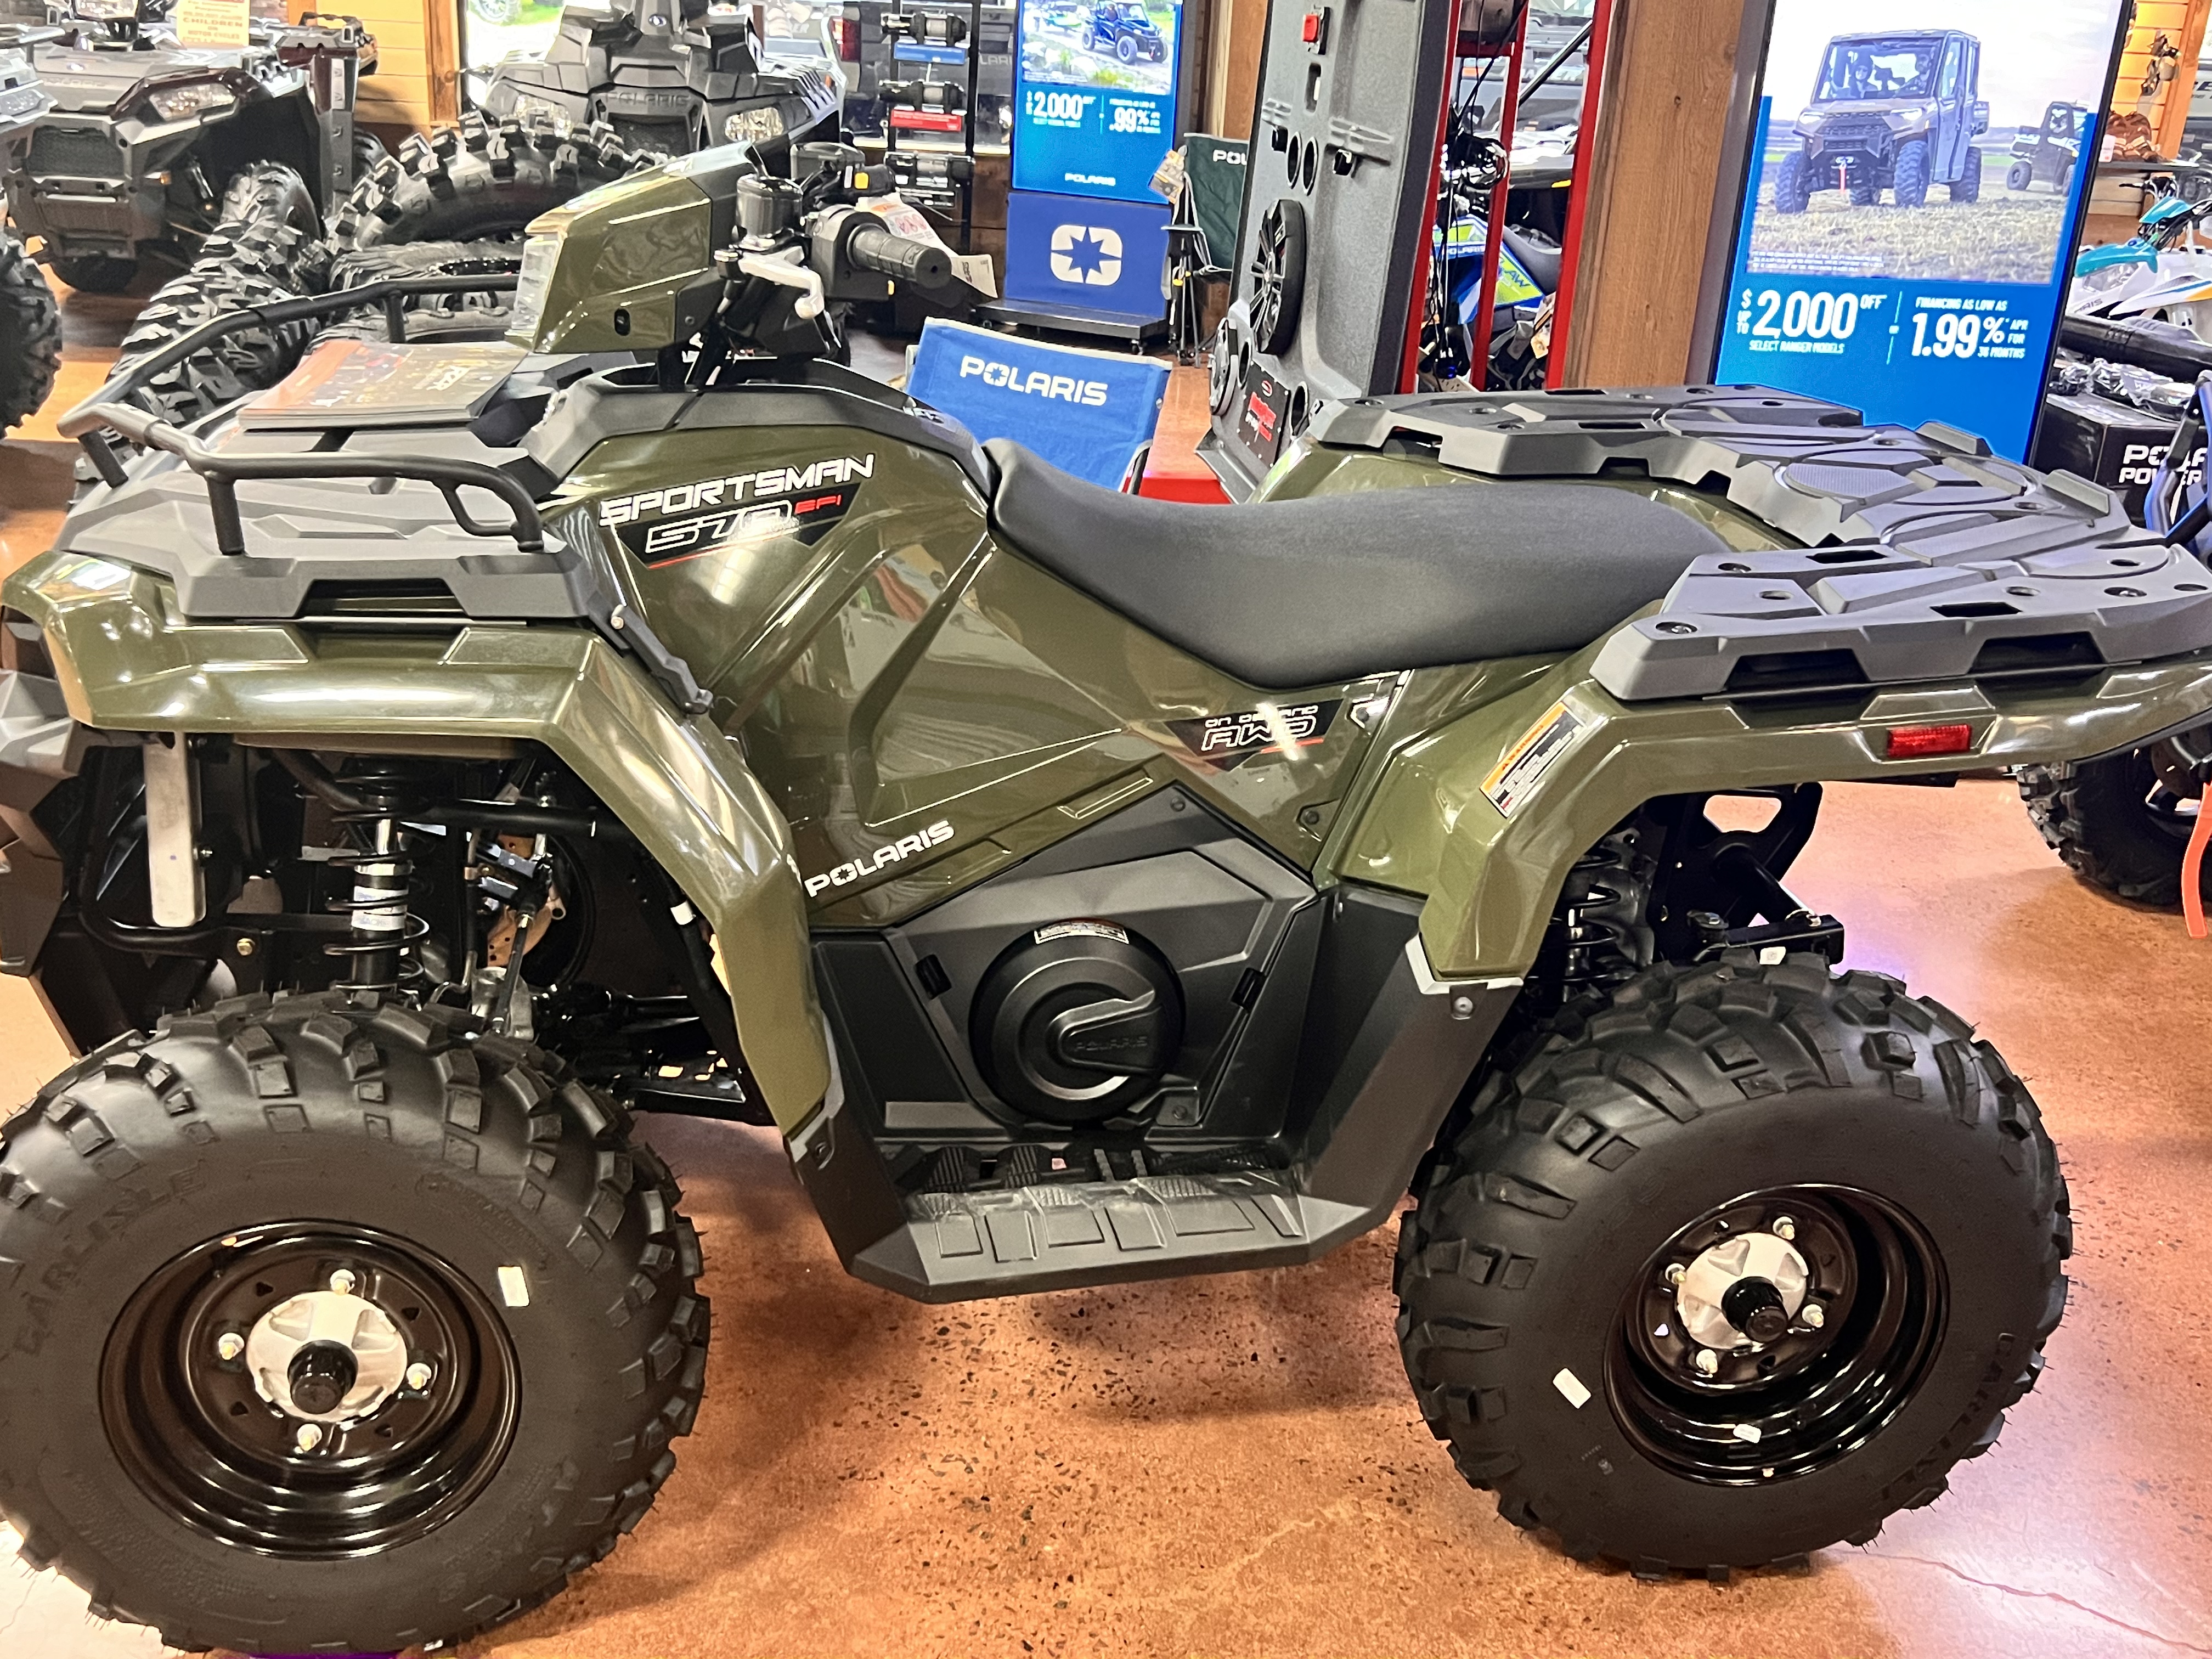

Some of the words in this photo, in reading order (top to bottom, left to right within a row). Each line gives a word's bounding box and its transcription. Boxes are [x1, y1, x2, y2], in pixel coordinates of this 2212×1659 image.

[183, 17, 242, 27] CHILDREN
[1065, 173, 1116, 187] POLARIS
[1915, 297, 1962, 309] FINANCING
[1962, 299, 1974, 311] AS
[1974, 300, 1995, 311] LOW
[1995, 300, 2008, 311] AS
[1752, 290, 1858, 339] 2,000
[1860, 294, 1887, 309] OFF
[2010, 319, 2029, 330] APR
[2007, 333, 2025, 344] FOR
[1749, 340, 1780, 352] SELECT
[1780, 341, 1812, 353] RANGER
[1813, 342, 1844, 354] MODELS
[1990, 347, 2025, 359] MONTHS
[960, 356, 1108, 406] POLARIS
[599, 453, 875, 526] SPORTSMAN
[794, 494, 842, 515] EFI
[1205, 717, 1232, 728] ON
[1200, 715, 1317, 752] AWD
[804, 820, 955, 898] POLARIS
